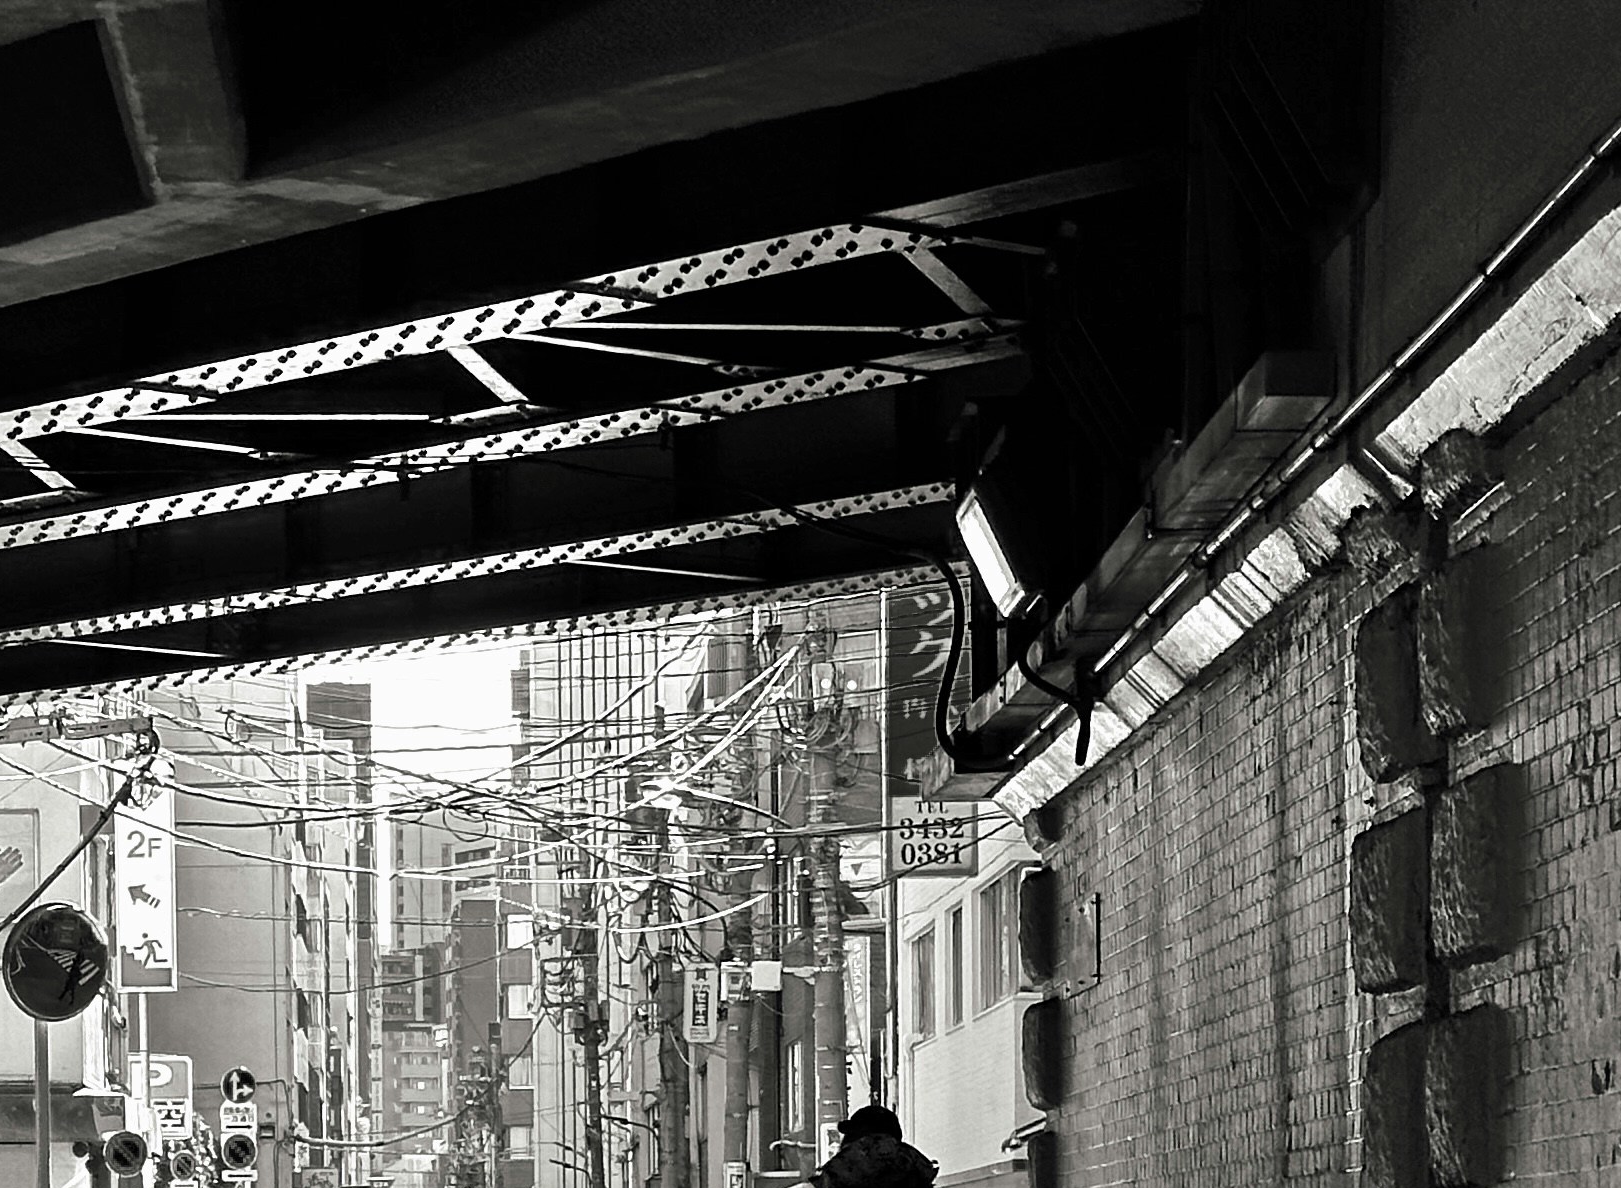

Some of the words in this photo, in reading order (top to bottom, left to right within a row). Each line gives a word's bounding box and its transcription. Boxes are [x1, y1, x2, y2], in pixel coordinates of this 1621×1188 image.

[900, 817, 964, 840] 3432
[127, 830, 162, 858] 2F
[901, 843, 962, 865] 0381
